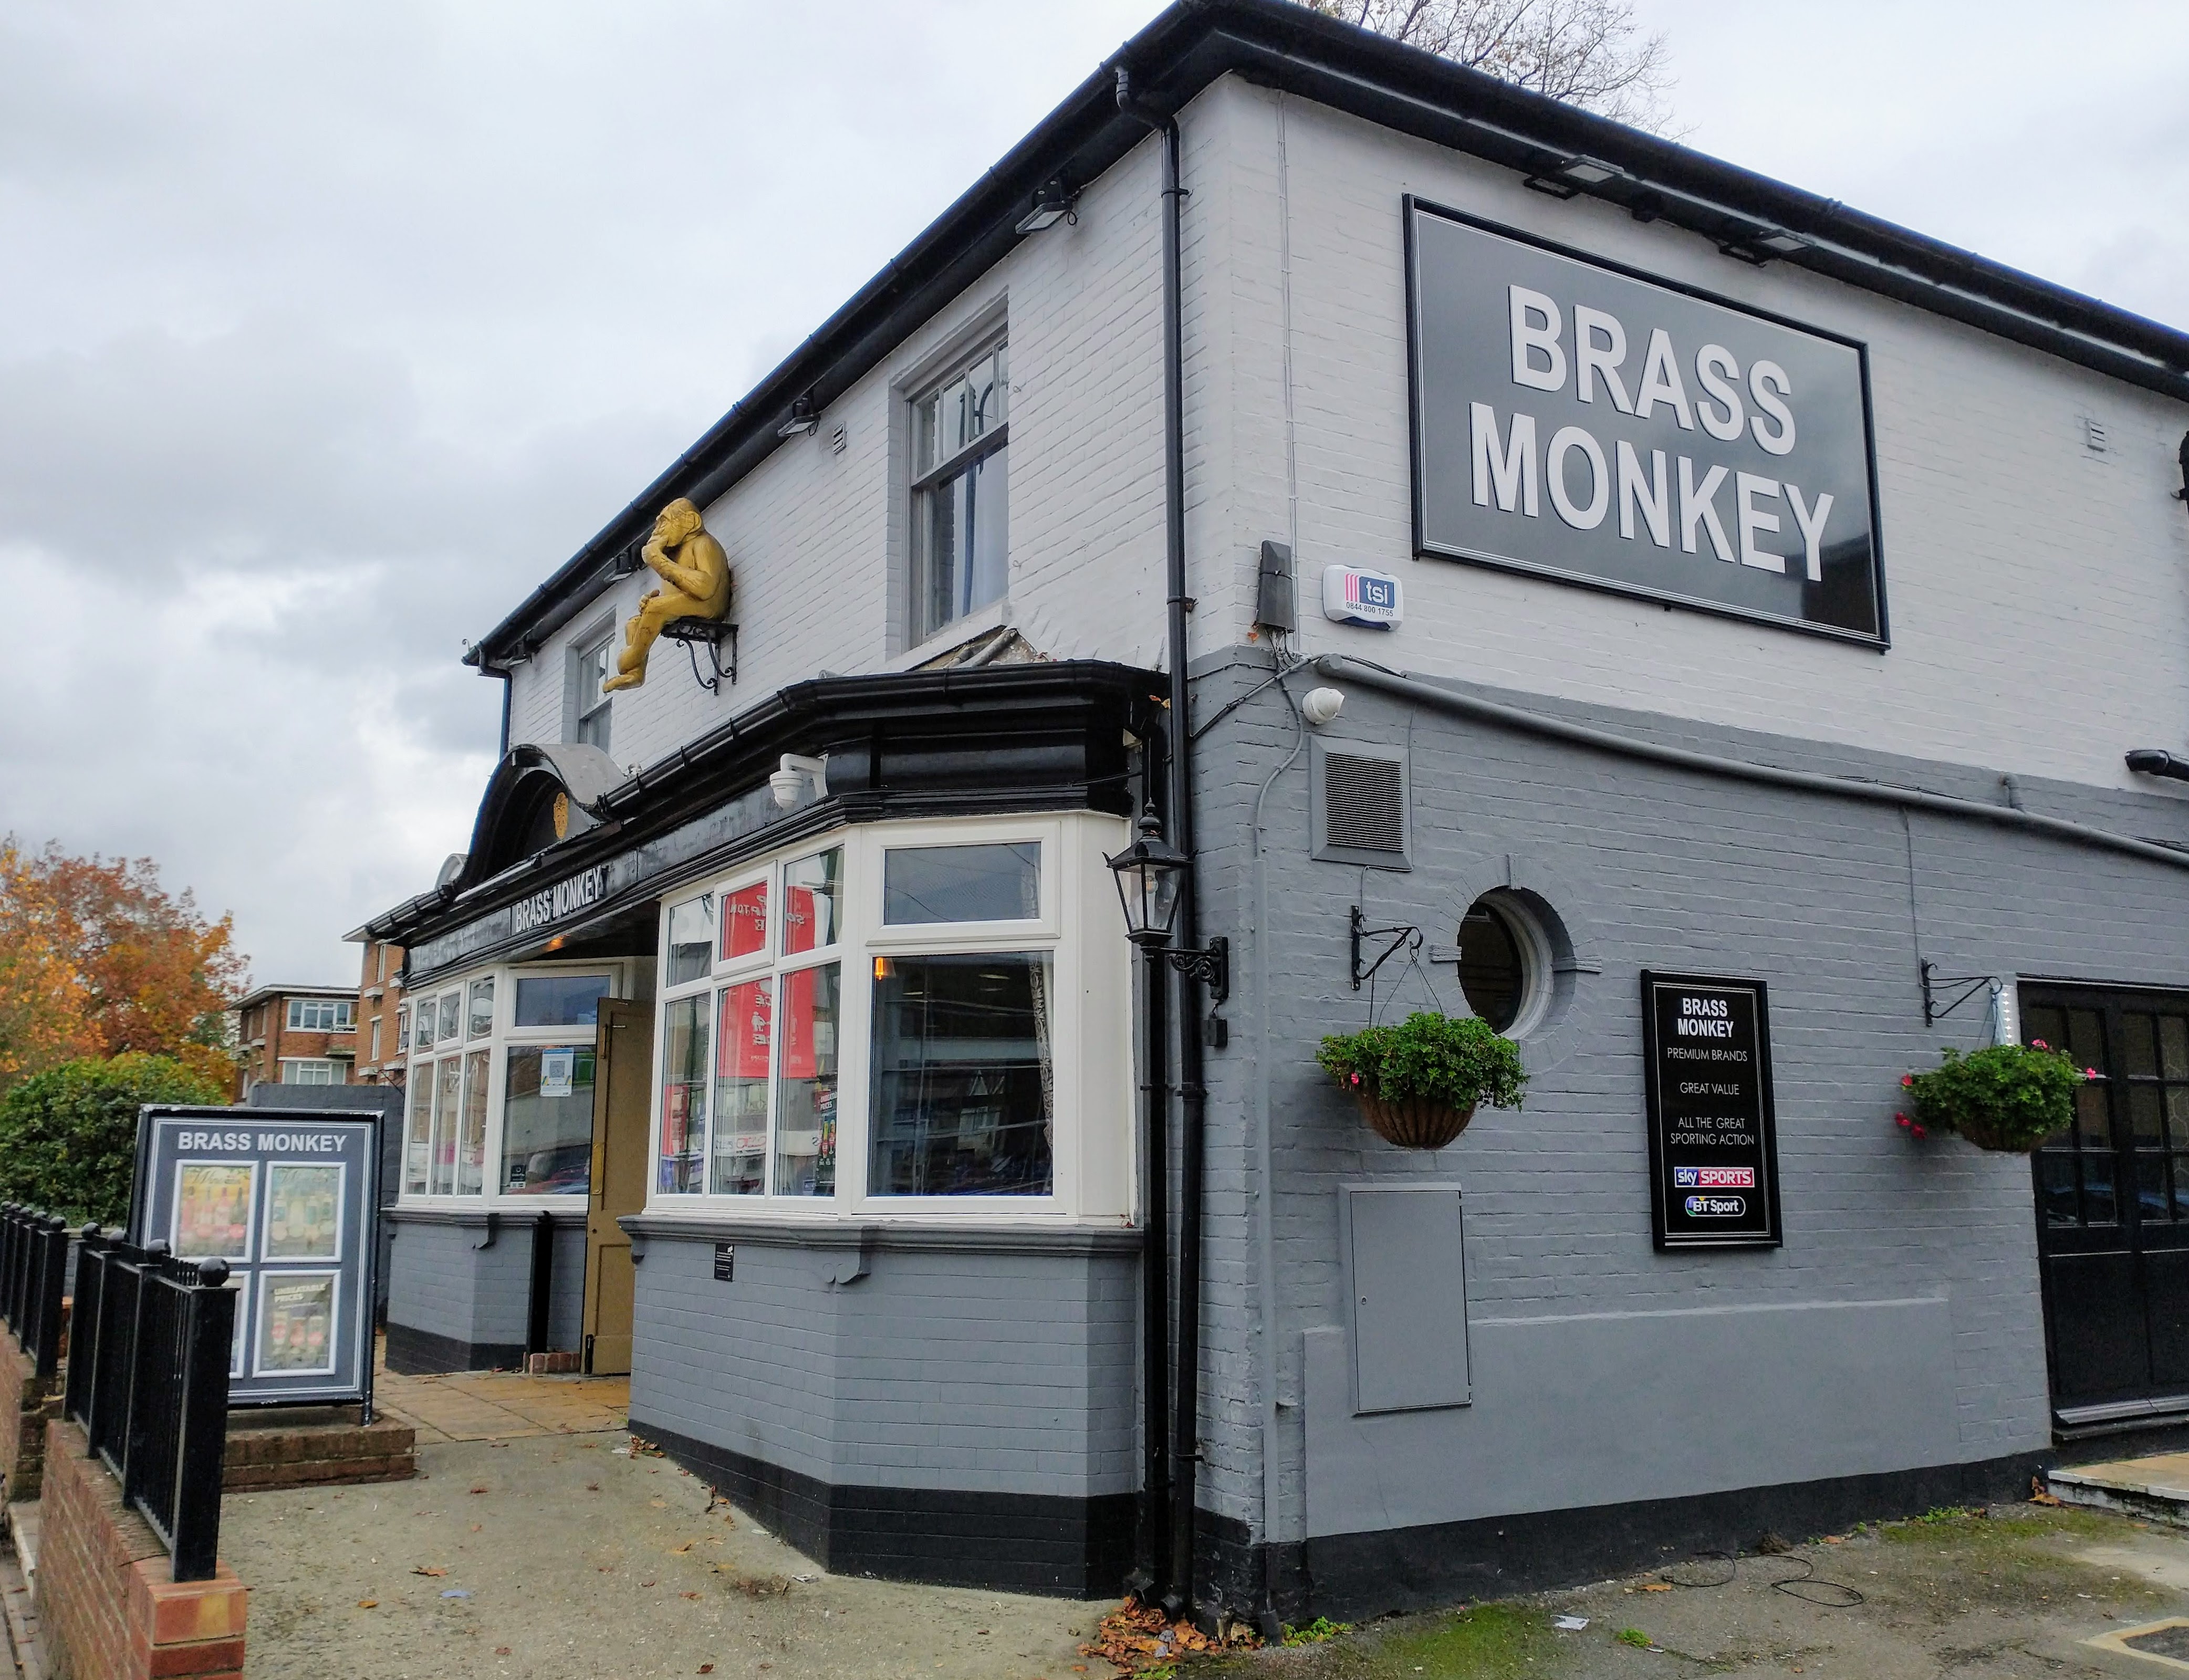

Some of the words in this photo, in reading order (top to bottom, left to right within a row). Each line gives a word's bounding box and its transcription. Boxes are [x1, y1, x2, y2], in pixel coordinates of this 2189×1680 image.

[1509, 284, 1796, 456] BRASS
[1470, 402, 1834, 582] MONKEY
[1366, 581, 1388, 604] tsi
[1346, 602, 1362, 611] 0844
[1364, 604, 1375, 613] 800
[1378, 608, 1393, 617] 1755
[516, 890, 550, 933] BRASS
[553, 865, 601, 918] MONKEY
[1682, 998, 1728, 1017] BRASS
[1677, 1018, 1734, 1038] MONKEY
[1667, 1047, 1709, 1060] PREMIUM
[1712, 1049, 1748, 1061] BRANDS
[1680, 1082, 1709, 1094] GREAT
[1711, 1083, 1739, 1095] VALUE
[1678, 1116, 1694, 1128] ALL
[1695, 1117, 1712, 1129] THE
[1716, 1118, 1745, 1129] GREAT
[178, 1132, 251, 1151] BRASS
[257, 1133, 347, 1152] MONKEY
[1671, 1133, 1717, 1145] SPORTING
[1719, 1134, 1754, 1145] ACTION
[1677, 1169, 1697, 1186] sky
[1701, 1171, 1752, 1184] SPORTS
[1693, 1201, 1709, 1212] BT
[1710, 1199, 1739, 1214] Sport
